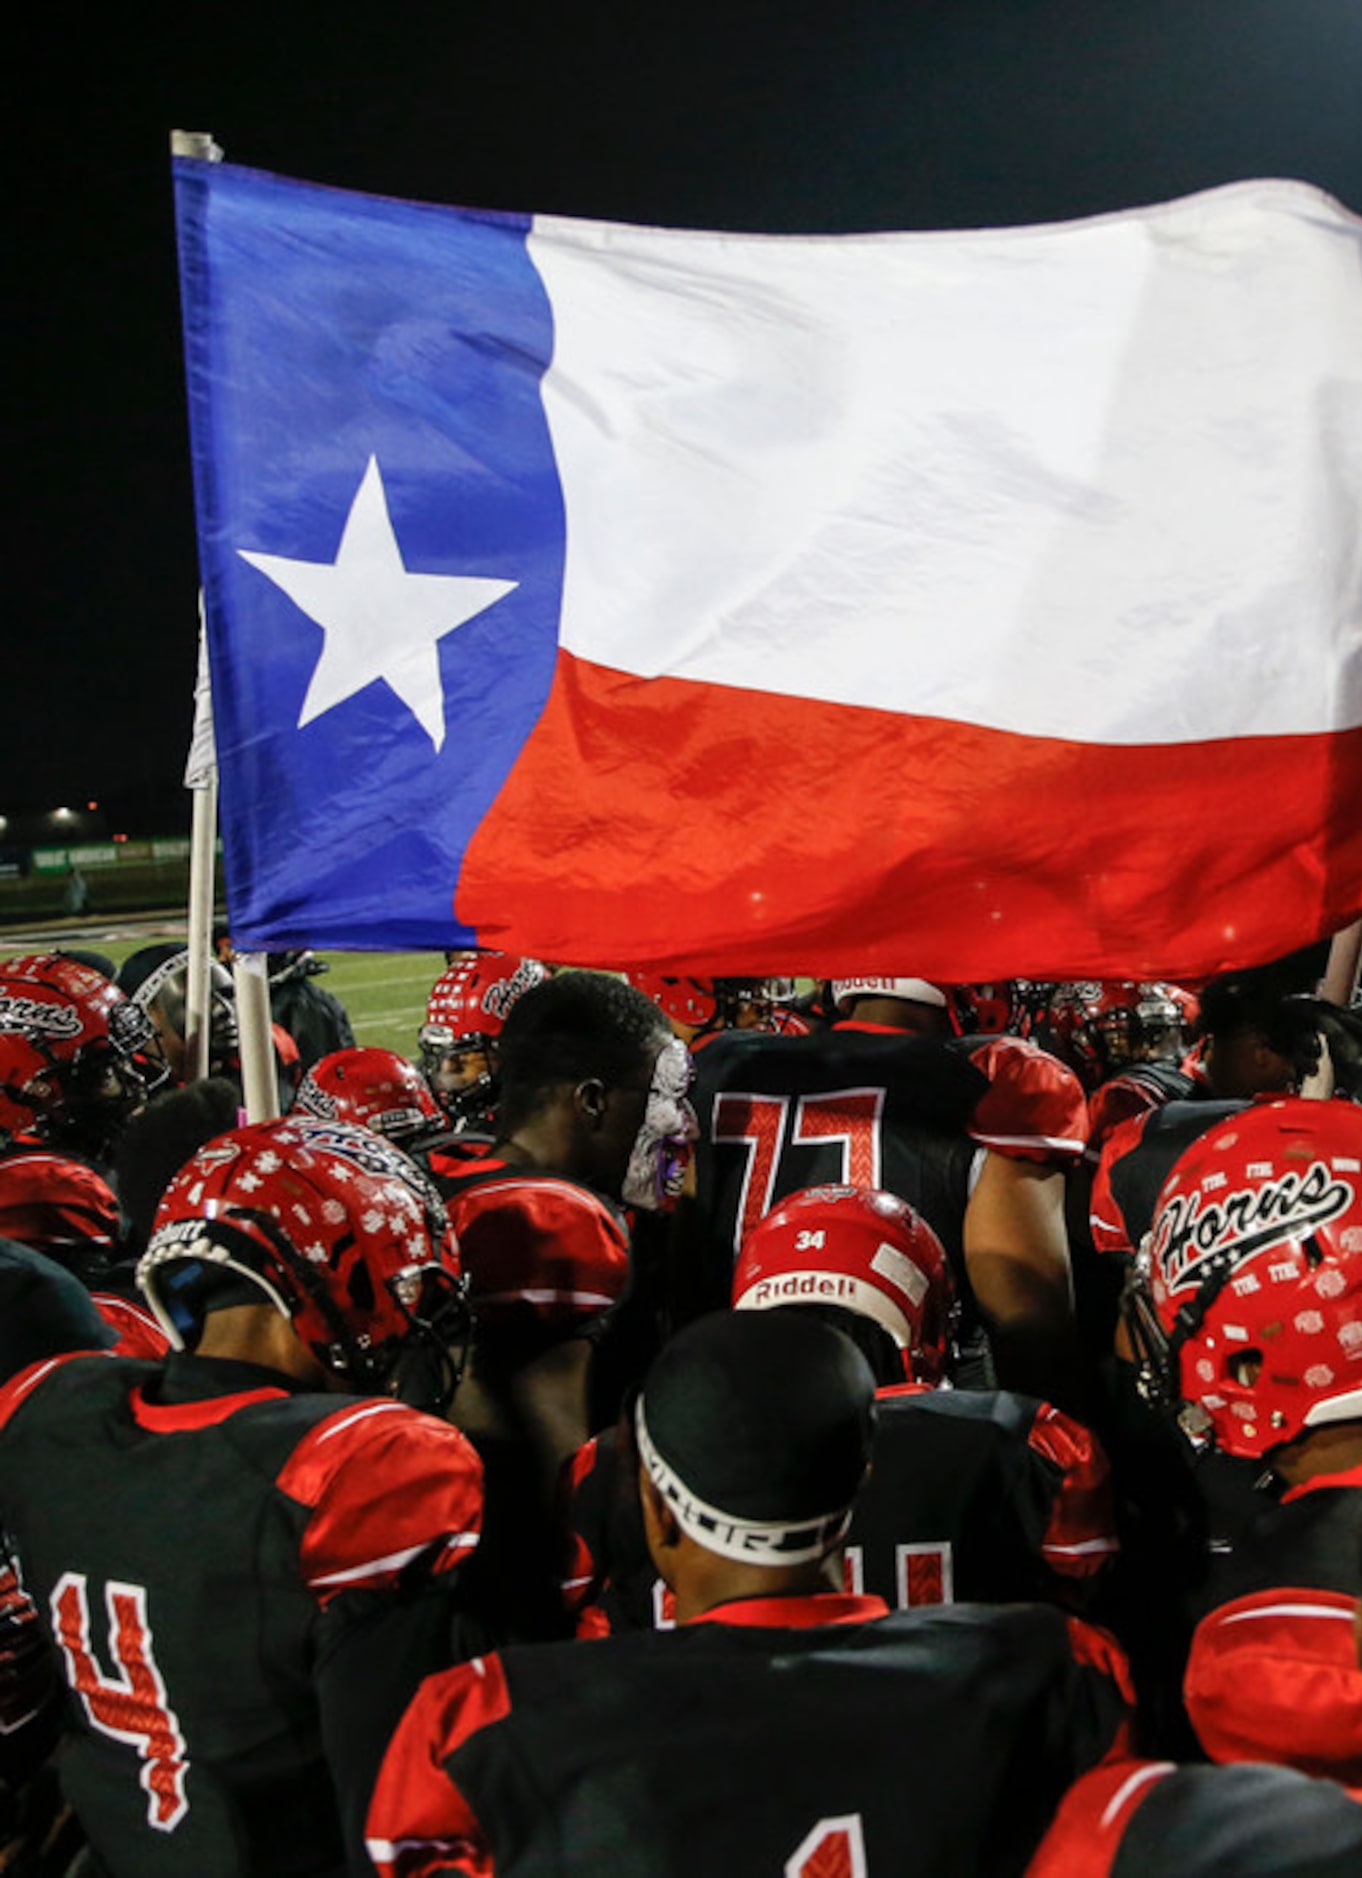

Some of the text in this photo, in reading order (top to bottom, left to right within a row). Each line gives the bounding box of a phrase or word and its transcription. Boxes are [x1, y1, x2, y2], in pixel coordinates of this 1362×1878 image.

[795, 1229, 827, 1251] 34
[1153, 1160, 1354, 1296] Horns
[755, 1276, 855, 1302] Riddell
[50, 1571, 190, 1832] 4
